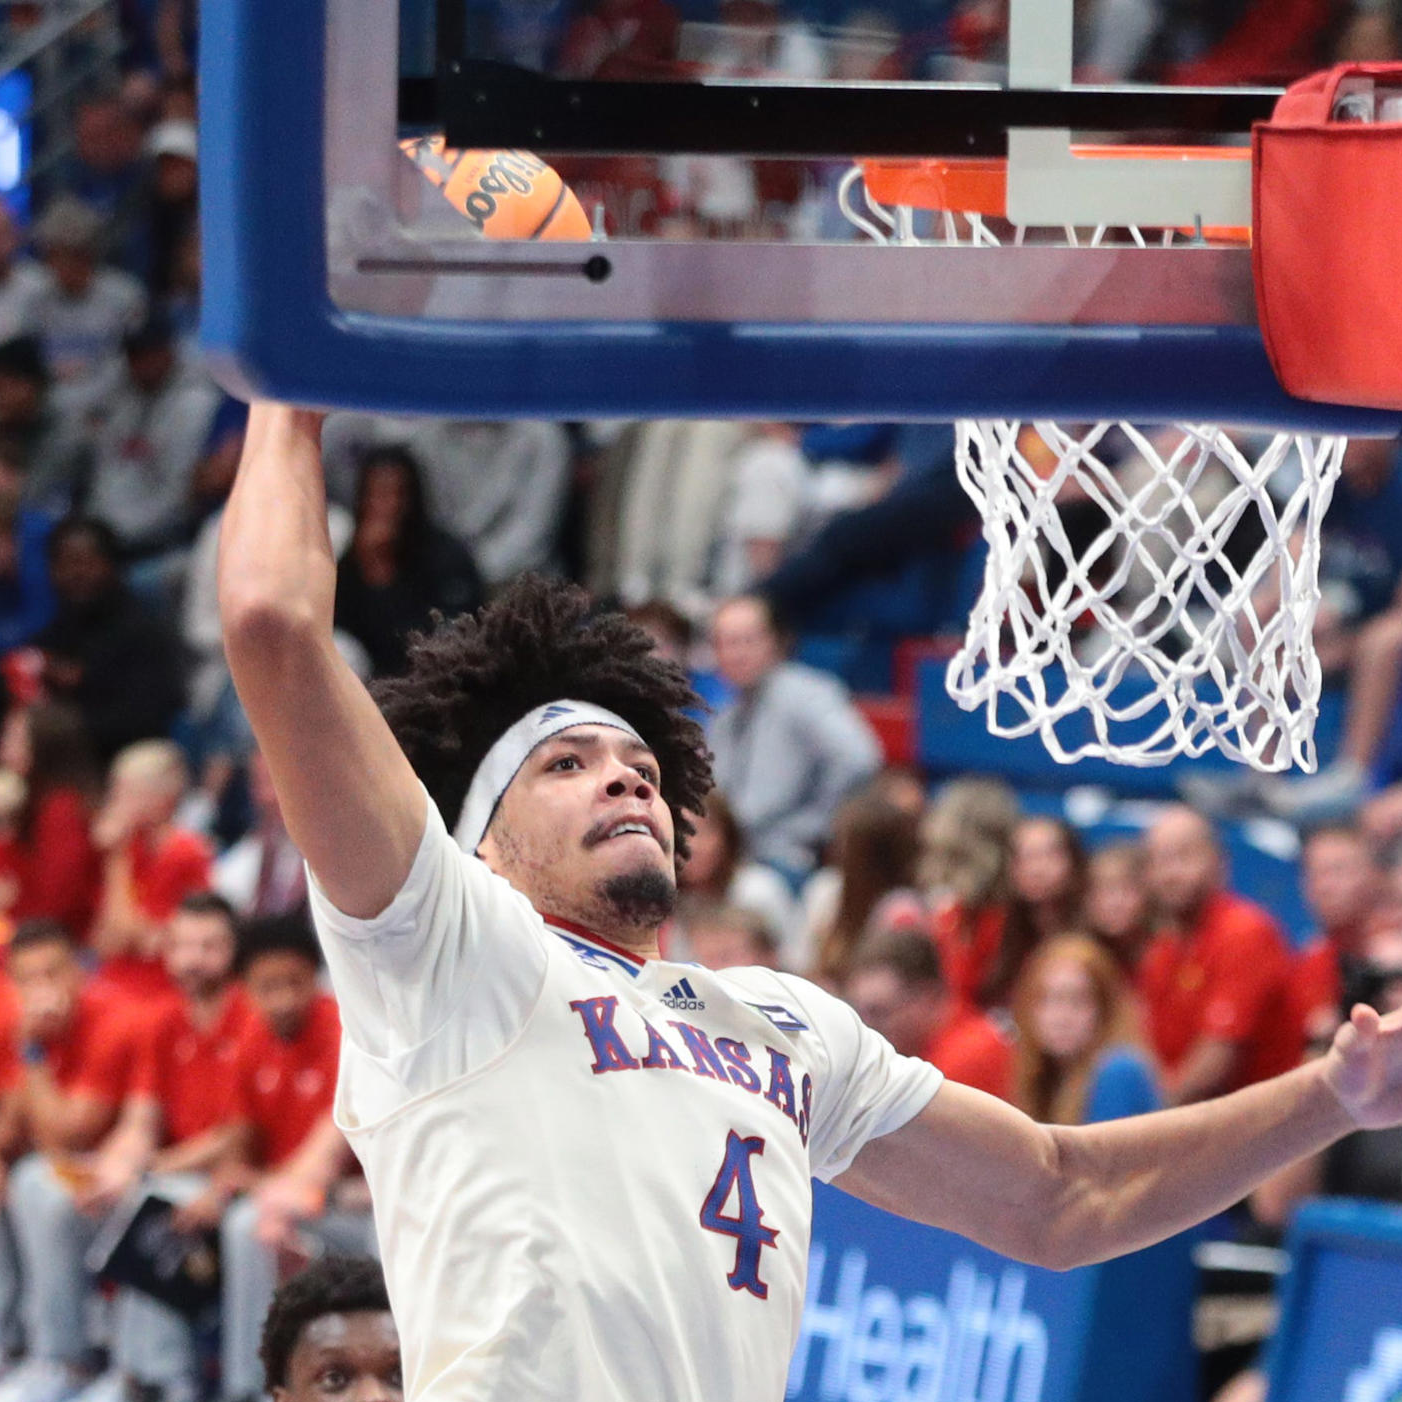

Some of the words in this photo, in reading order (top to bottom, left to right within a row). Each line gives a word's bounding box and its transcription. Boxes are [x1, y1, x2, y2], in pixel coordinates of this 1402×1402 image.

[465, 149, 547, 231] ilso
[570, 996, 812, 1149] KANSAS
[700, 1129, 781, 1300] 4
